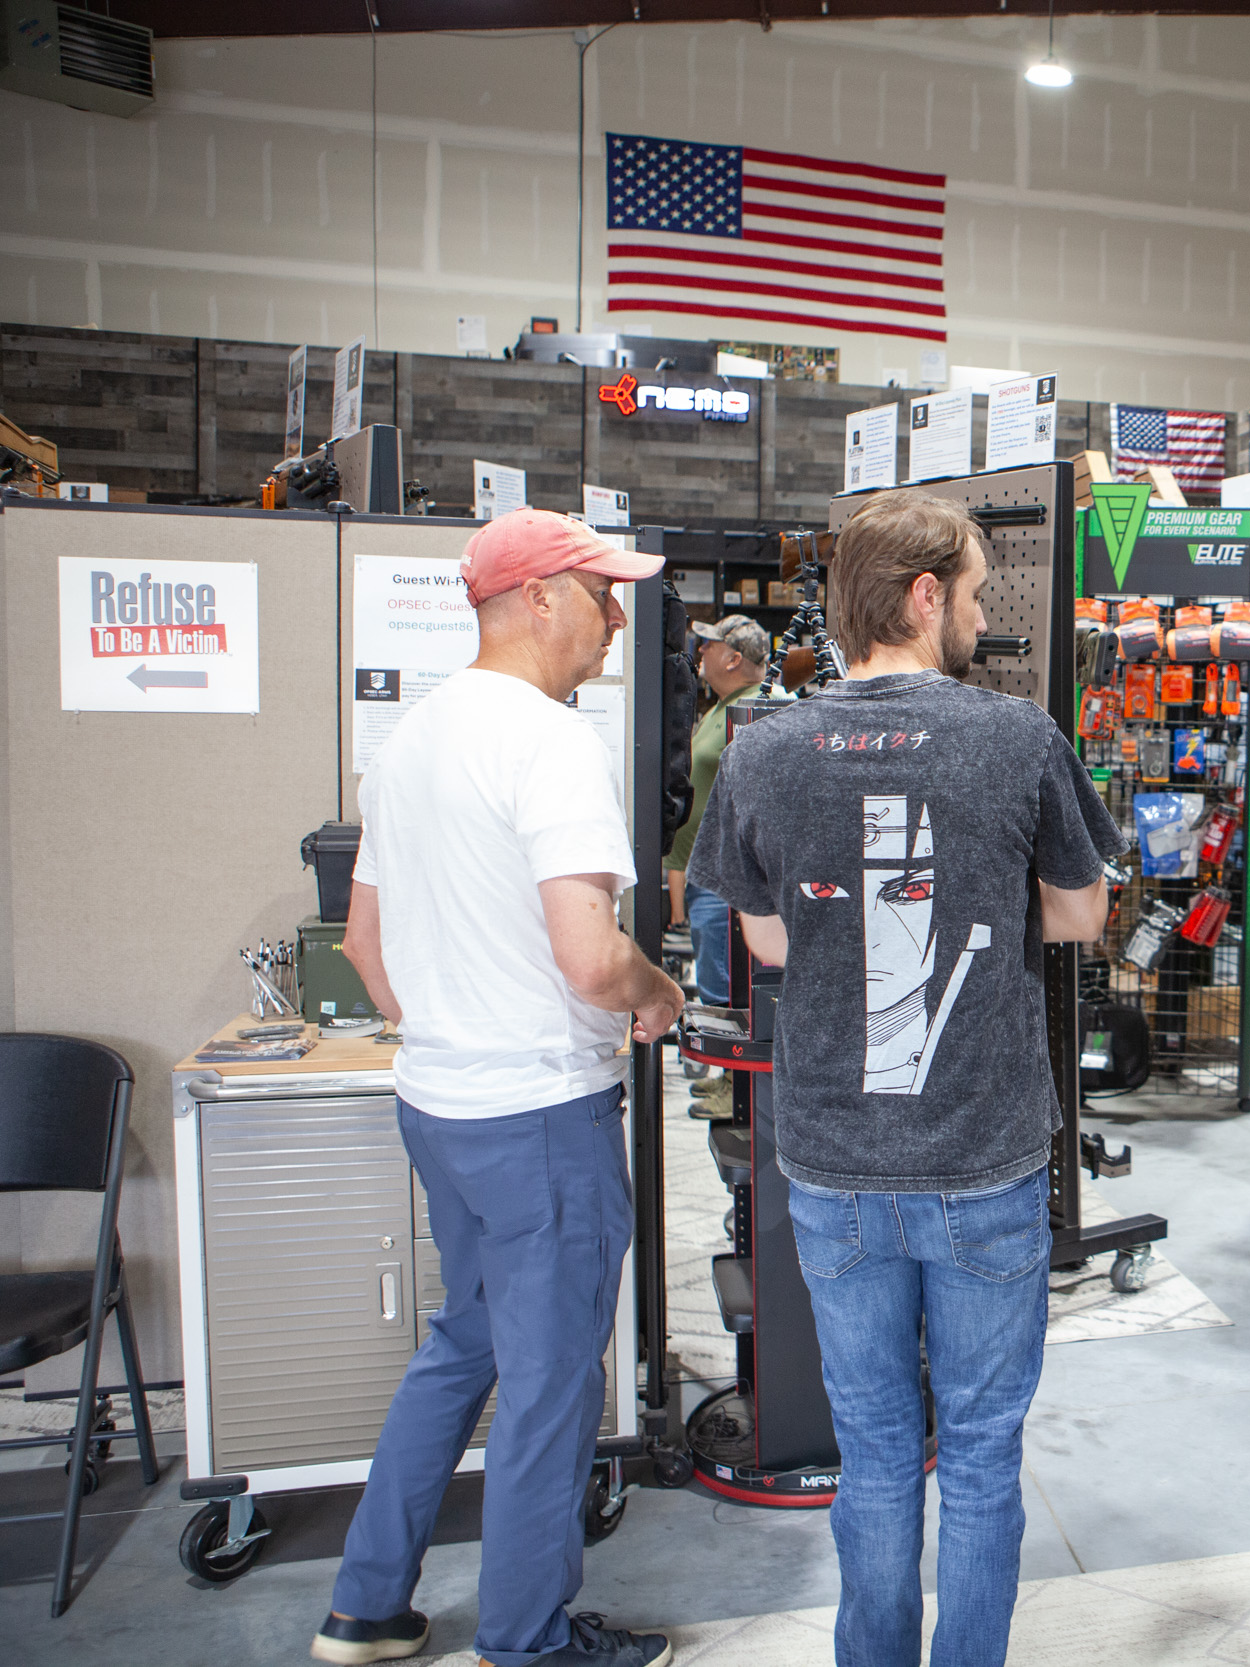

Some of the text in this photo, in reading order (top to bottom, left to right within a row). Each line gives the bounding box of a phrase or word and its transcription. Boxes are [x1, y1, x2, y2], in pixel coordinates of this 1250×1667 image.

[998, 384, 1030, 397] SHOTGUNS
[1146, 512, 1243, 525] PREMIUM GEAR
[1143, 525, 1238, 536] FOR EVERY SCENARIO.
[1195, 544, 1246, 560] ELITE
[392, 574, 430, 585] Guest
[91, 571, 216, 626] Refuse
[387, 599, 431, 610] OPSEC
[388, 621, 474, 632] opsecguest86
[95, 628, 224, 654] To Be A Victim.
[813, 730, 932, 752] うちはイタチ
